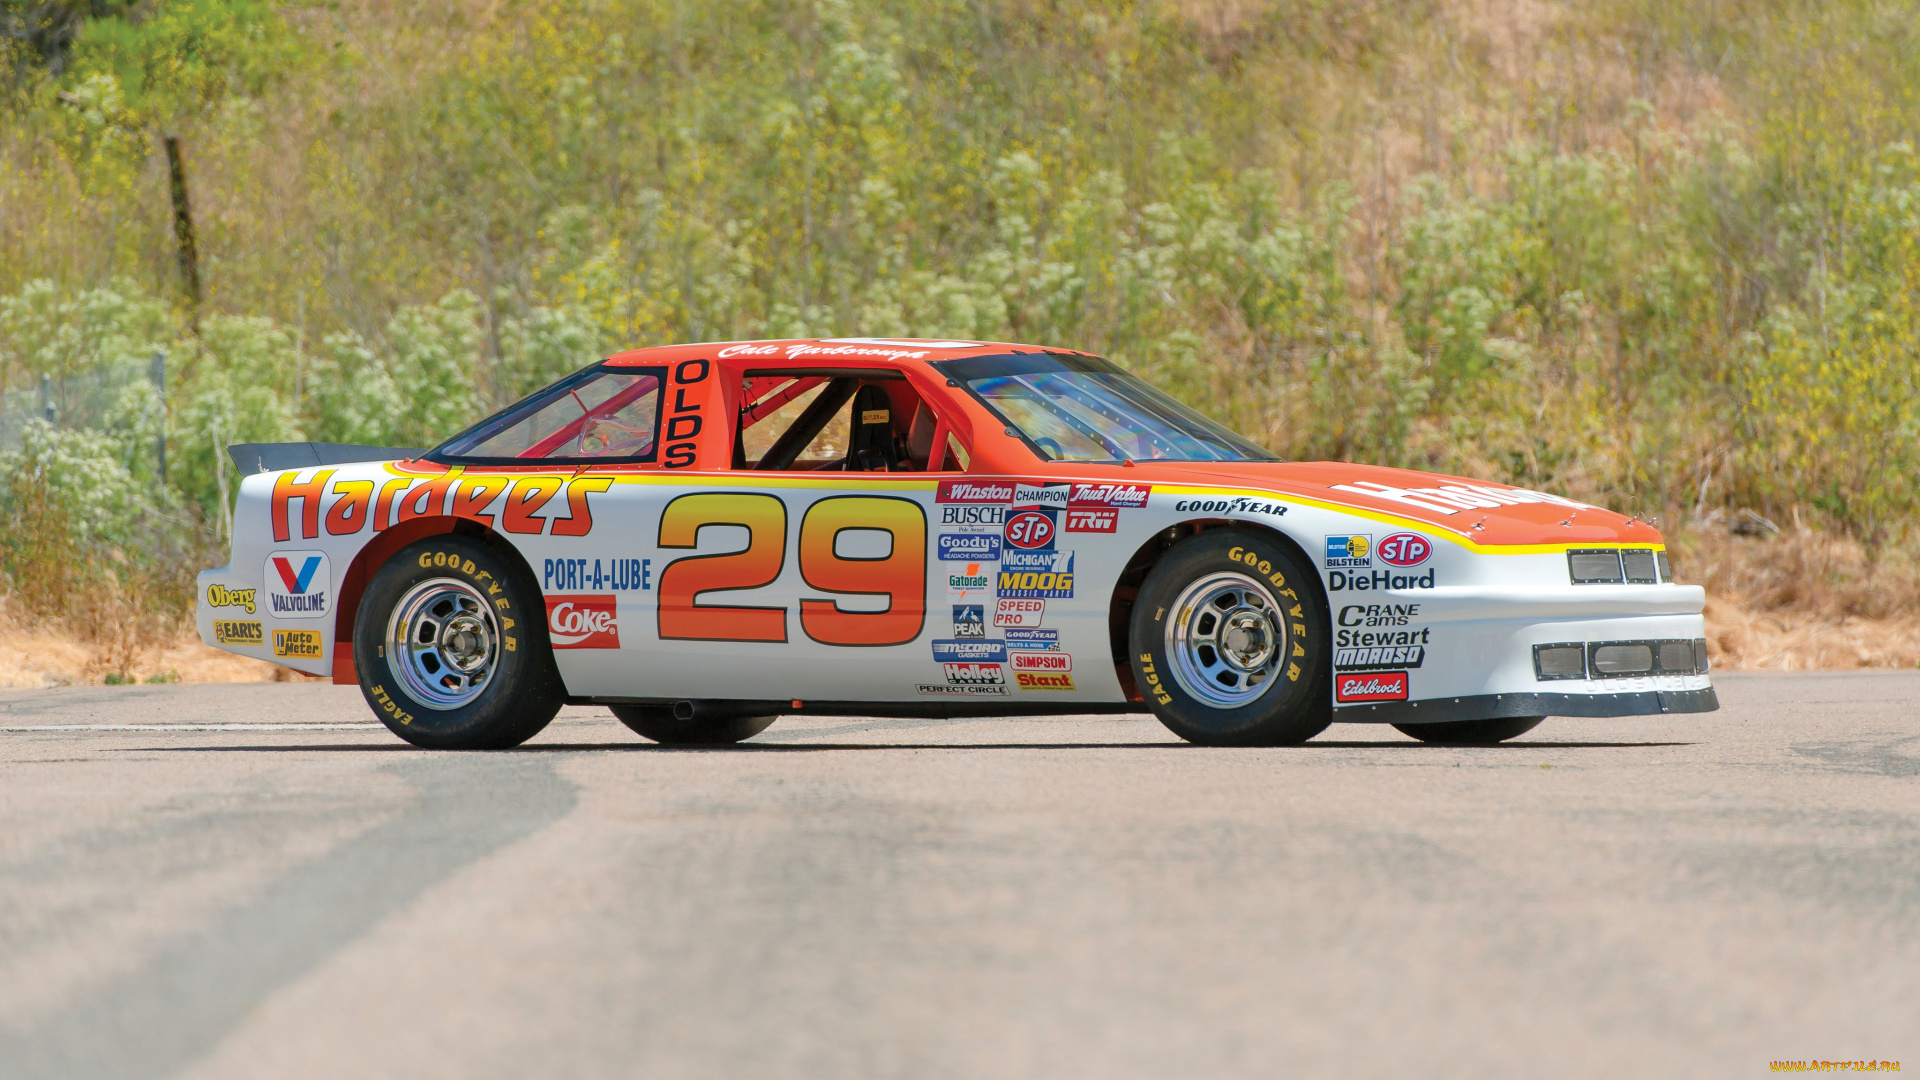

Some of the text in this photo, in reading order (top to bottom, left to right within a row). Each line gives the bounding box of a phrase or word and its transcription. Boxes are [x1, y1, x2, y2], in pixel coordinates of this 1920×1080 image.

[718, 344, 931, 361] Cale Yarborough
[664, 358, 710, 469] OLDS
[950, 484, 1013, 500] Winston
[1015, 490, 1068, 502] CHAMPION
[941, 507, 1005, 524] BUSCH
[1175, 498, 1288, 516] GOODYEAR
[1069, 511, 1115, 529] TRW
[1010, 516, 1049, 545] STP
[940, 536, 1000, 552] Goody's
[1382, 536, 1425, 563] STP
[657, 491, 929, 647] 29
[1326, 558, 1370, 567] BILSTEIN
[544, 558, 651, 591] PORT-A-LUBE
[949, 575, 988, 587] Gatorade
[998, 572, 1074, 590] MOOG
[1329, 568, 1435, 591] DieHard
[207, 584, 256, 614] Oberg
[271, 591, 325, 612] VALVOLINE
[418, 551, 517, 652] GOODYEAR
[1001, 589, 1038, 597] CHASSIS
[999, 601, 1042, 612] SPEED
[1228, 546, 1306, 682] GOODYEAR
[550, 602, 618, 634] Coke
[995, 614, 1023, 624] PRO
[223, 622, 263, 639] EARL'S
[286, 632, 313, 643] Auto
[953, 622, 984, 636] PEAK
[1006, 630, 1056, 640] GOODYEAR
[1336, 627, 1430, 647] Stewart
[285, 643, 319, 655] Meter
[1335, 645, 1424, 669] MOROSO
[1015, 656, 1066, 668] SIMPSON
[945, 664, 1003, 683] Holley
[1017, 673, 1072, 687] Stant
[1139, 652, 1173, 705] EAGLE
[919, 685, 966, 693] PERFECT
[968, 686, 1006, 694] CIRCLE
[1341, 679, 1403, 696] Edelbrock
[371, 684, 414, 726] EAGLE
